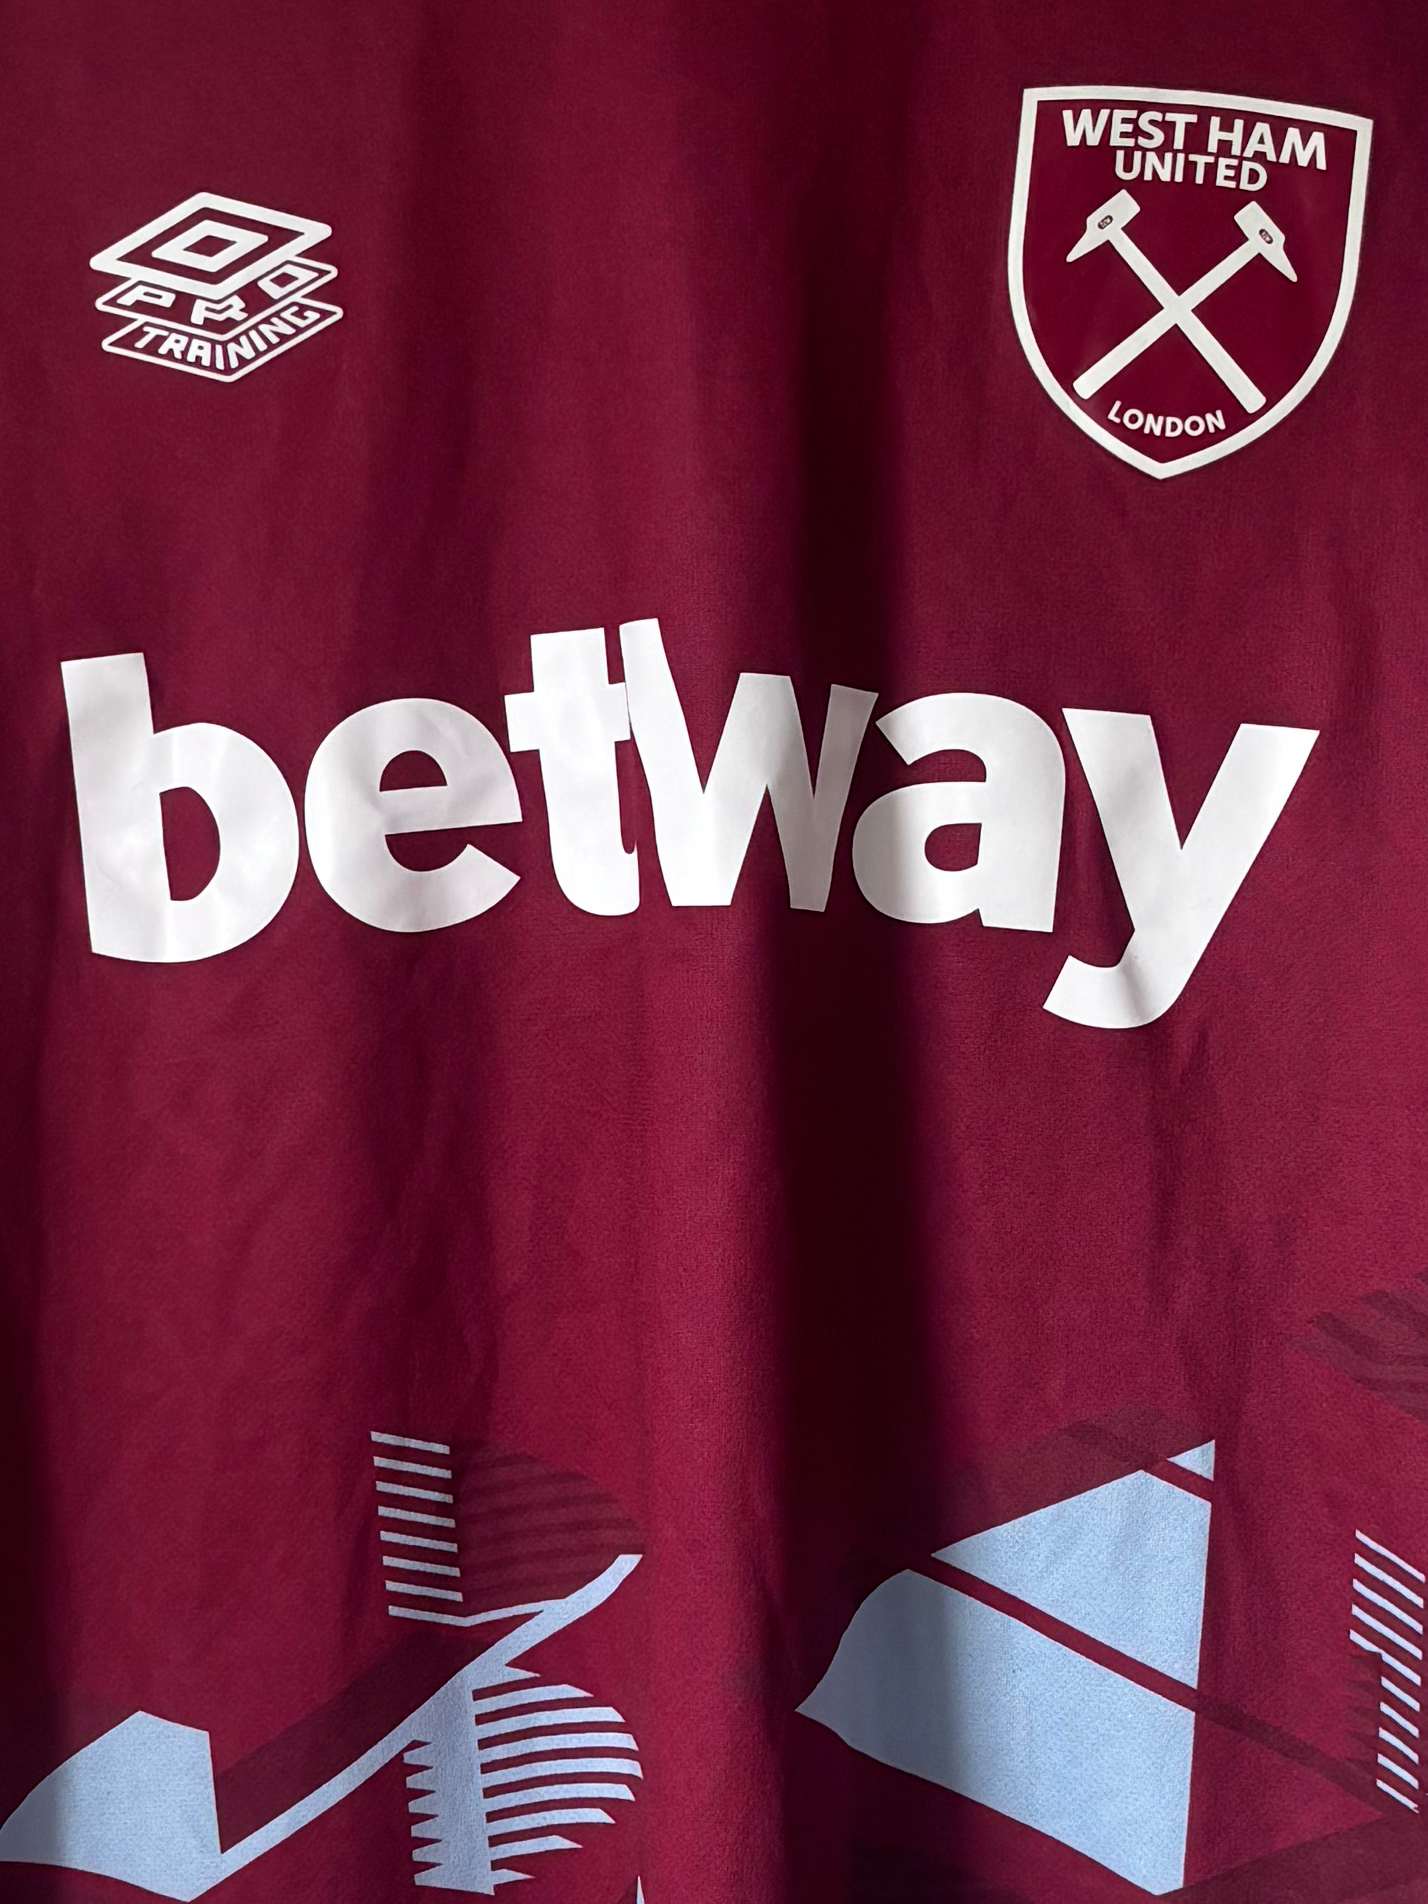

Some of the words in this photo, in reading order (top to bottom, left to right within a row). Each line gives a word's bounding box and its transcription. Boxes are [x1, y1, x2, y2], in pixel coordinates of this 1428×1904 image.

[1062, 108, 1198, 150] WEST
[1207, 116, 1327, 171] HAM
[1115, 150, 1269, 192] UNITED
[116, 262, 320, 326] PRO
[134, 305, 321, 371] TRAINING
[1107, 400, 1227, 438] LONDON
[59, 617, 1321, 1030] betway
